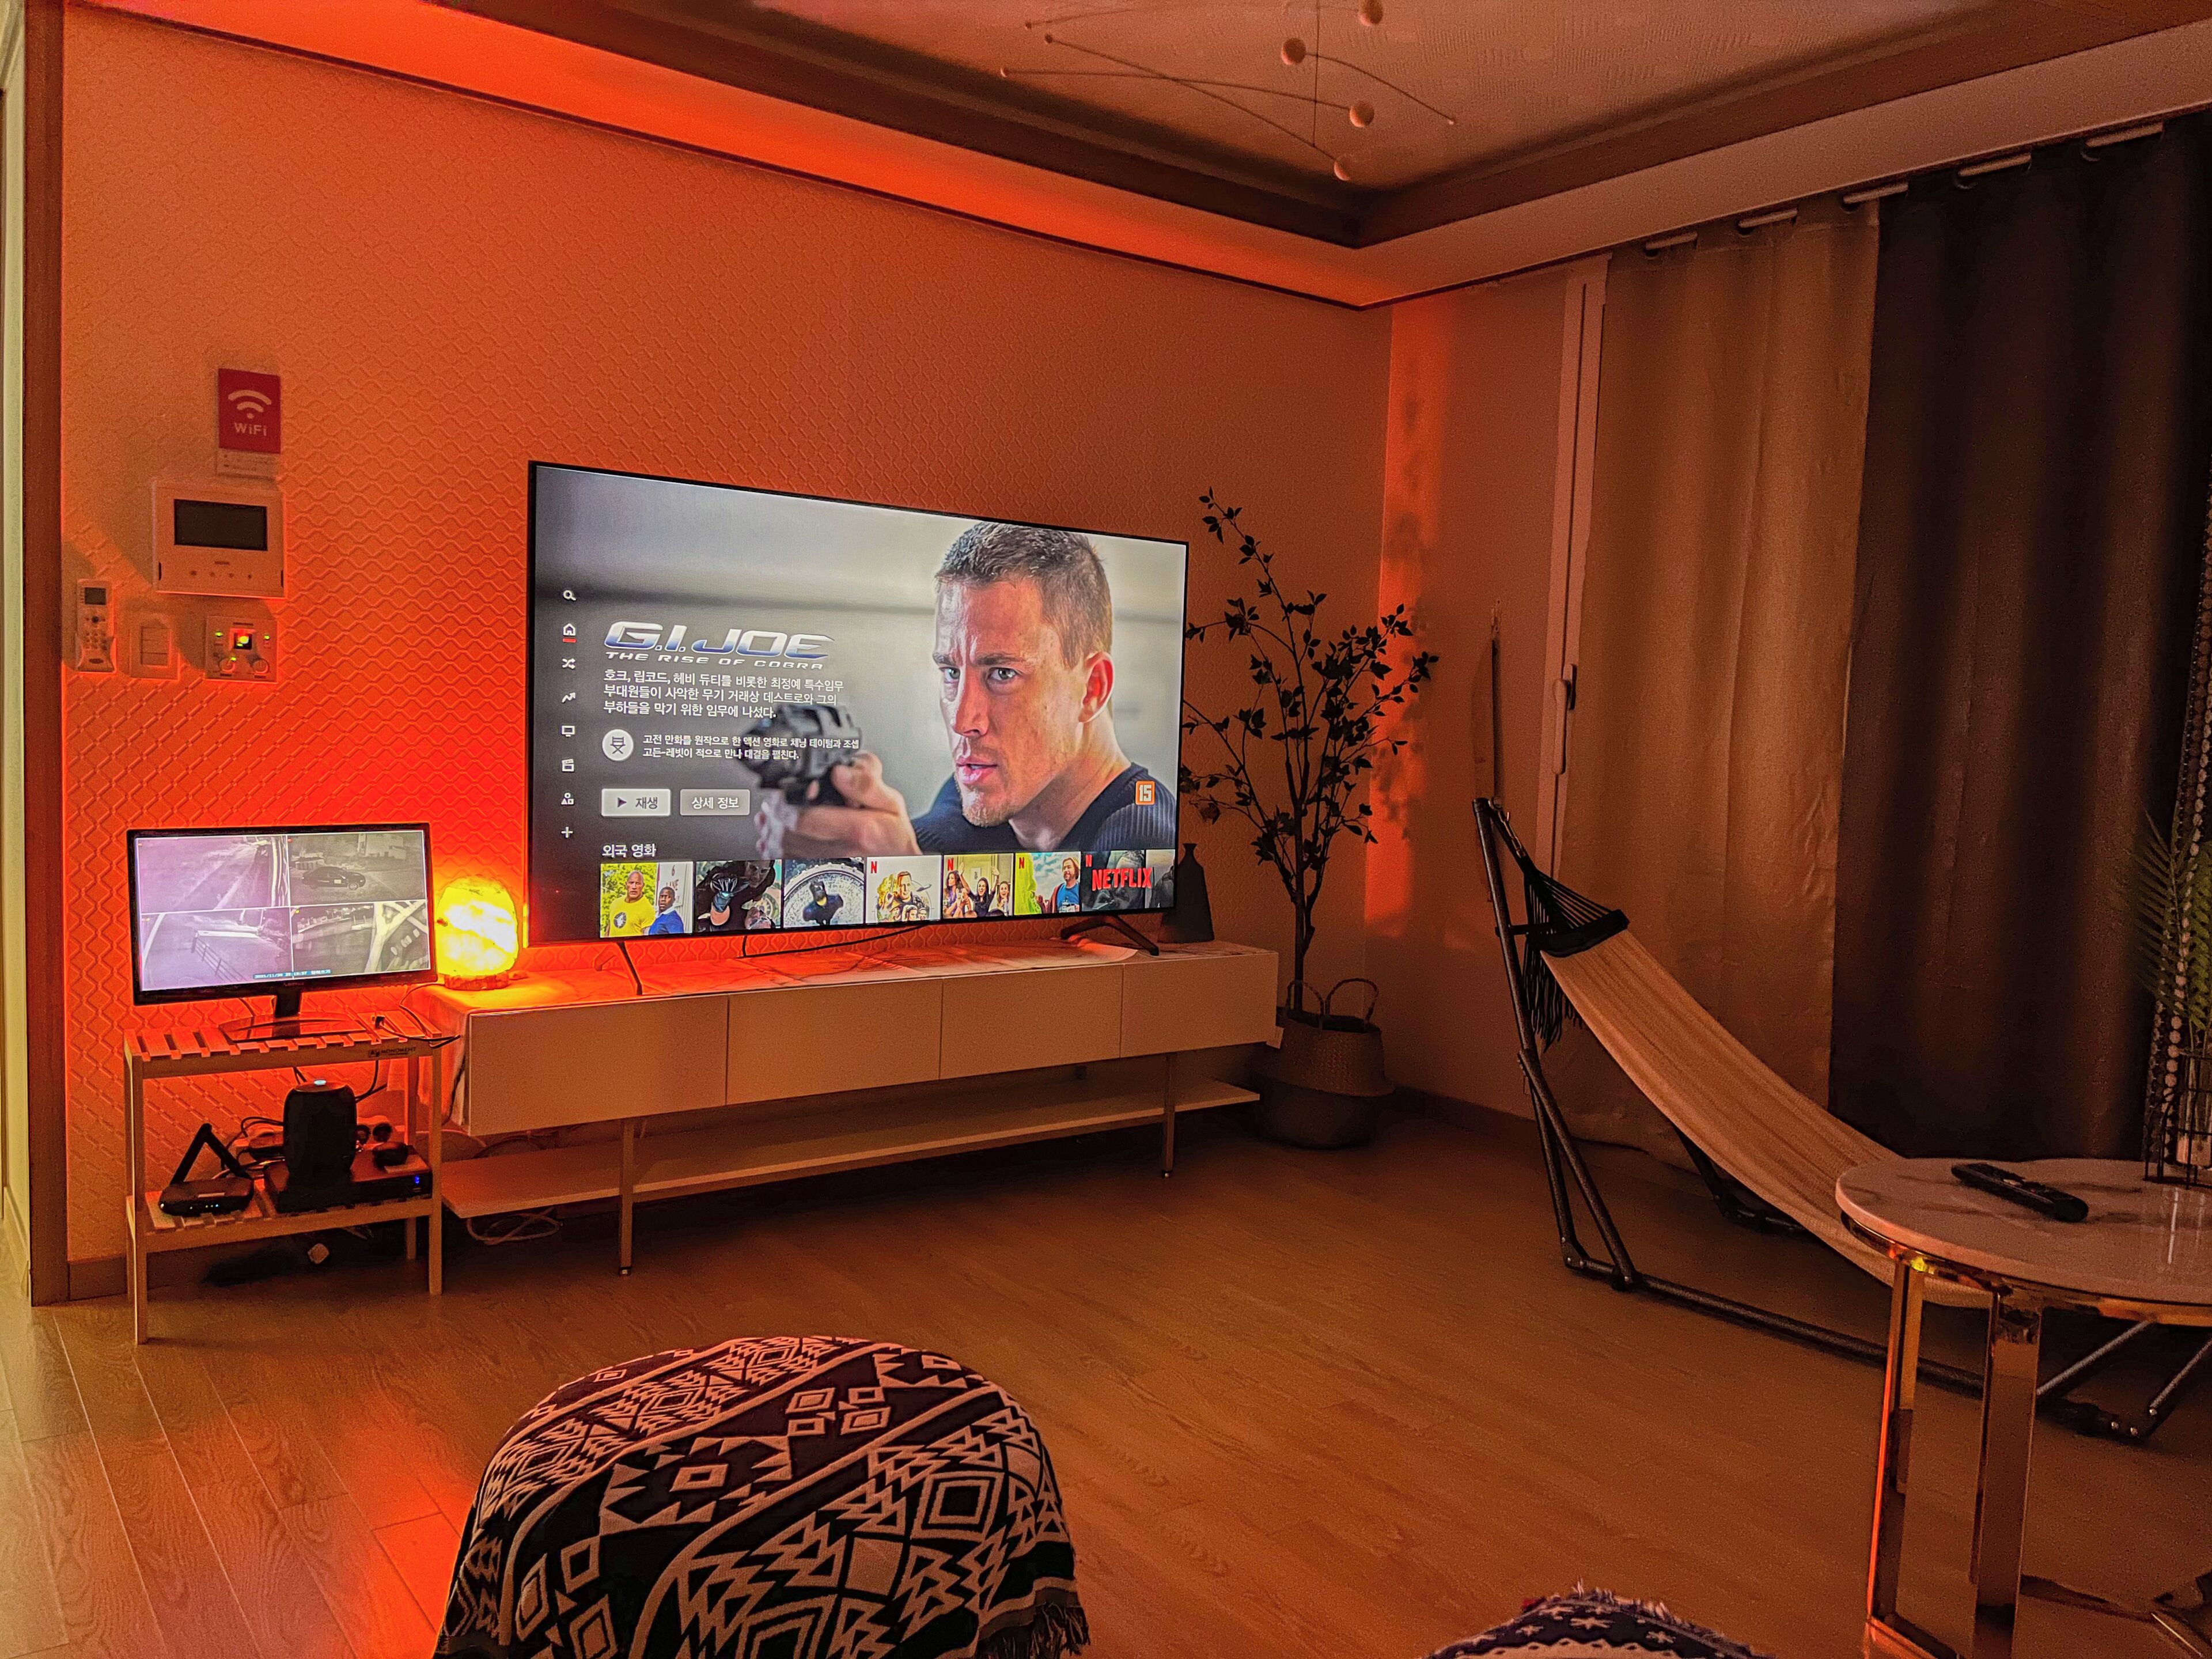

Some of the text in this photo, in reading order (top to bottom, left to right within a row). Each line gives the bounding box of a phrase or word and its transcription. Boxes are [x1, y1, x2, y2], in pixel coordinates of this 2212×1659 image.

[234, 422, 267, 436] WiFi
[605, 652, 649, 661] THE
[658, 654, 709, 665] RISE
[754, 660, 824, 671] COBRA
[604, 669, 844, 692] 호크, 립코드, 헤비 듀티를 비롯한 최정예 특수임무
[604, 684, 836, 706] 부대원들이 사악한 무기 거래상 데스트로와 그의
[604, 700, 777, 719] 부하들을 막기 위한 임무에 나섰다.
[643, 734, 859, 749] 고전 만화를 원작으로 한 액션 영화로 채닝 테이텀과 조셉
[643, 748, 800, 760] 고든-레빗이 적으로 만나 대결을 펼친다.
[1139, 784, 1152, 802] 15
[635, 797, 658, 809] 재생
[691, 797, 739, 809] 상세 정보
[602, 843, 657, 858] 외국 영화
[870, 861, 877, 874] N
[947, 858, 954, 871] N
[1018, 857, 1025, 869] N
[1085, 855, 1092, 867] N
[671, 864, 675, 876] 6
[1092, 868, 1152, 891] NETFLIX
